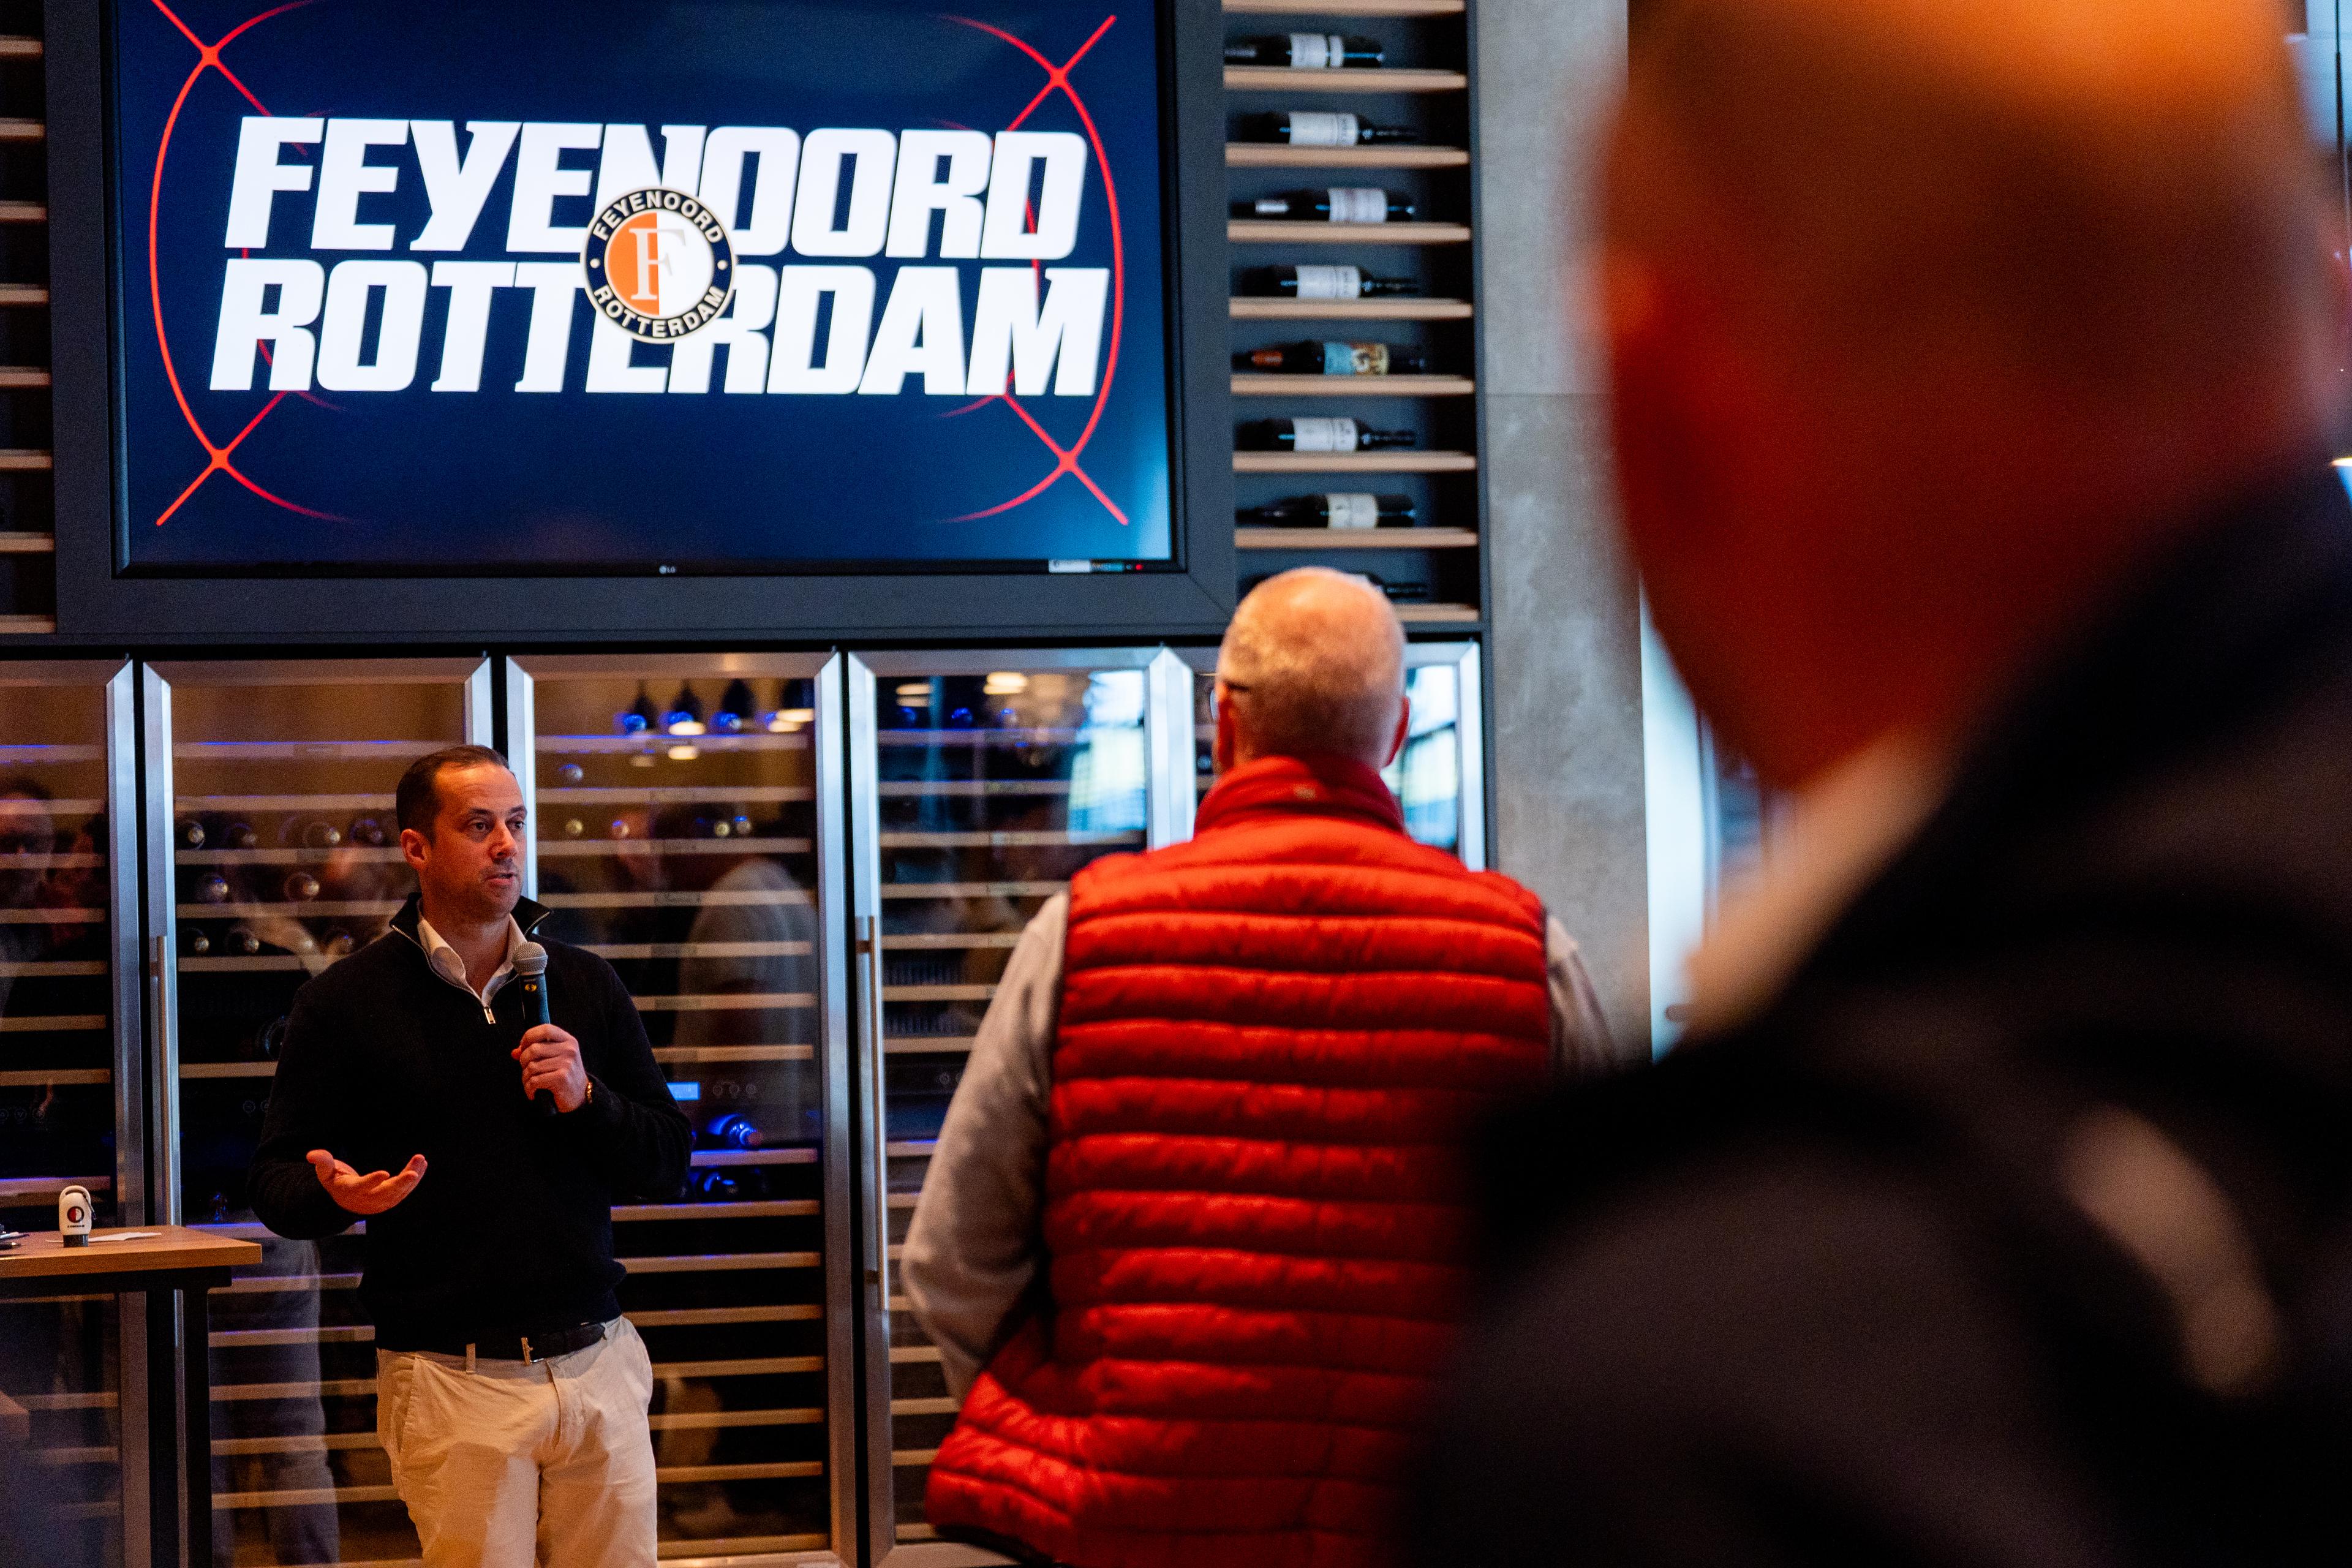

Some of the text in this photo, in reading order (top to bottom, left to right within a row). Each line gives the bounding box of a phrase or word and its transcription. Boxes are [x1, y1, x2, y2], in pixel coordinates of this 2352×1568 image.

[224, 116, 1087, 260] FEYENOORD
[592, 190, 723, 243] FEYENOORD
[628, 228, 687, 300] F
[594, 285, 725, 337] ROTTERDAM
